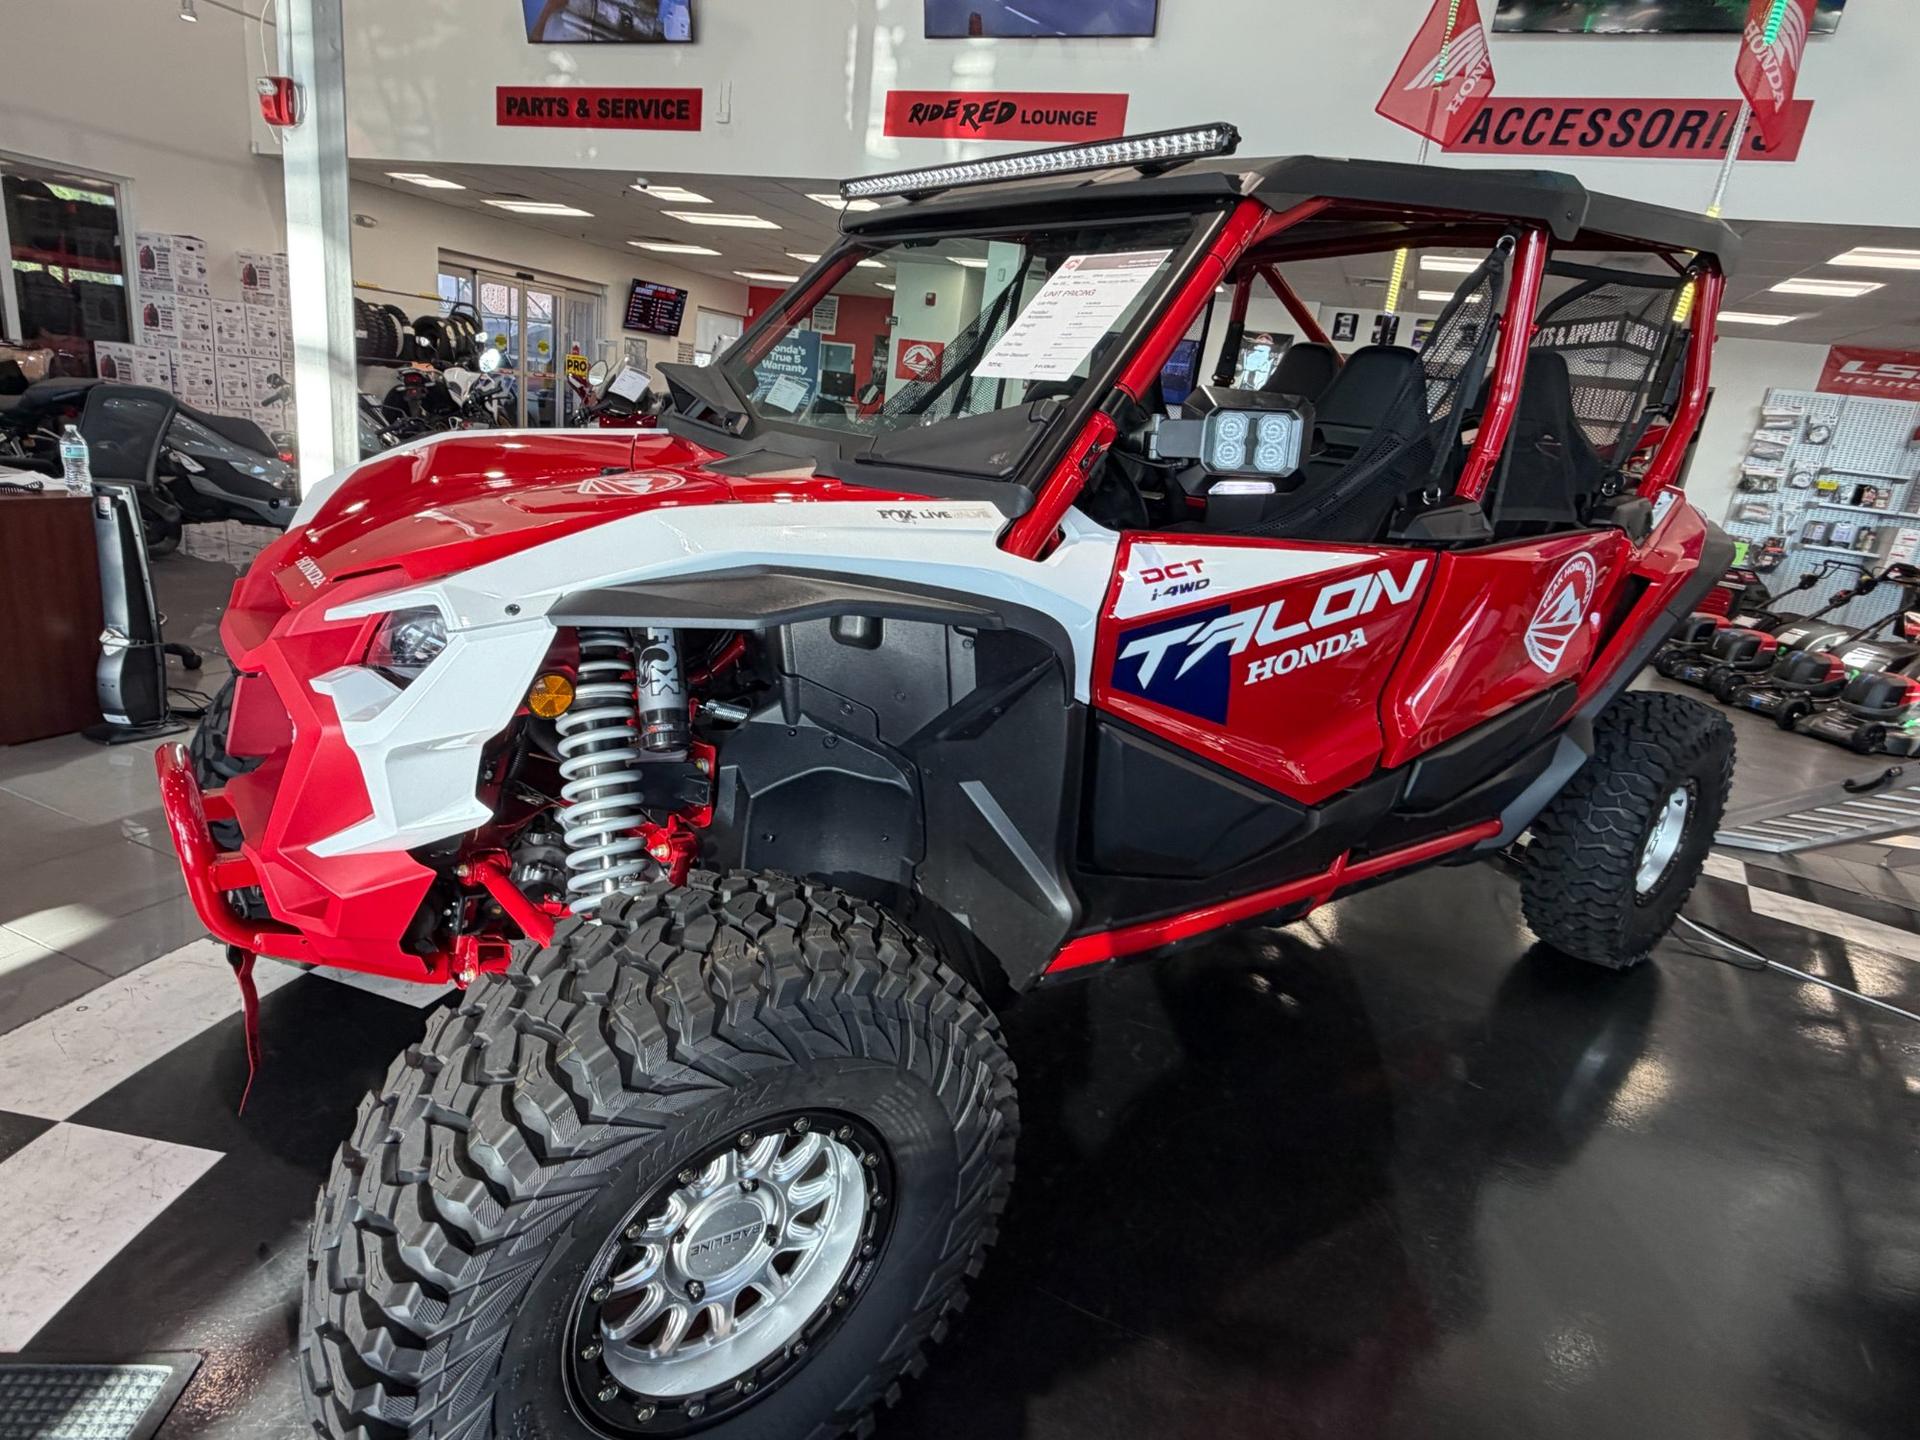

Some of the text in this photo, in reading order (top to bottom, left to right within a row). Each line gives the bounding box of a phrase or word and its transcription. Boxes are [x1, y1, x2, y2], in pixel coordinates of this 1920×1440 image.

[1744, 19, 1784, 113] HONDA
[506, 96, 690, 120] PARTS & SERVICE
[908, 99, 1098, 132] RIDE RED LOUNGE
[1461, 106, 1768, 152] ACCESSORI
[770, 351, 802, 364] True 5
[774, 345, 806, 356] onda's
[567, 359, 587, 371] PRO
[762, 360, 808, 375] Warranty
[1840, 360, 1920, 379] LS
[877, 510, 917, 525] FOX
[295, 556, 326, 589] HONDA
[1139, 559, 1204, 585] DCT
[1151, 578, 1210, 602] i-4WD
[1118, 558, 1428, 690] TALON
[1244, 627, 1367, 686] HONDA
[690, 1223, 763, 1257] RACELINE
